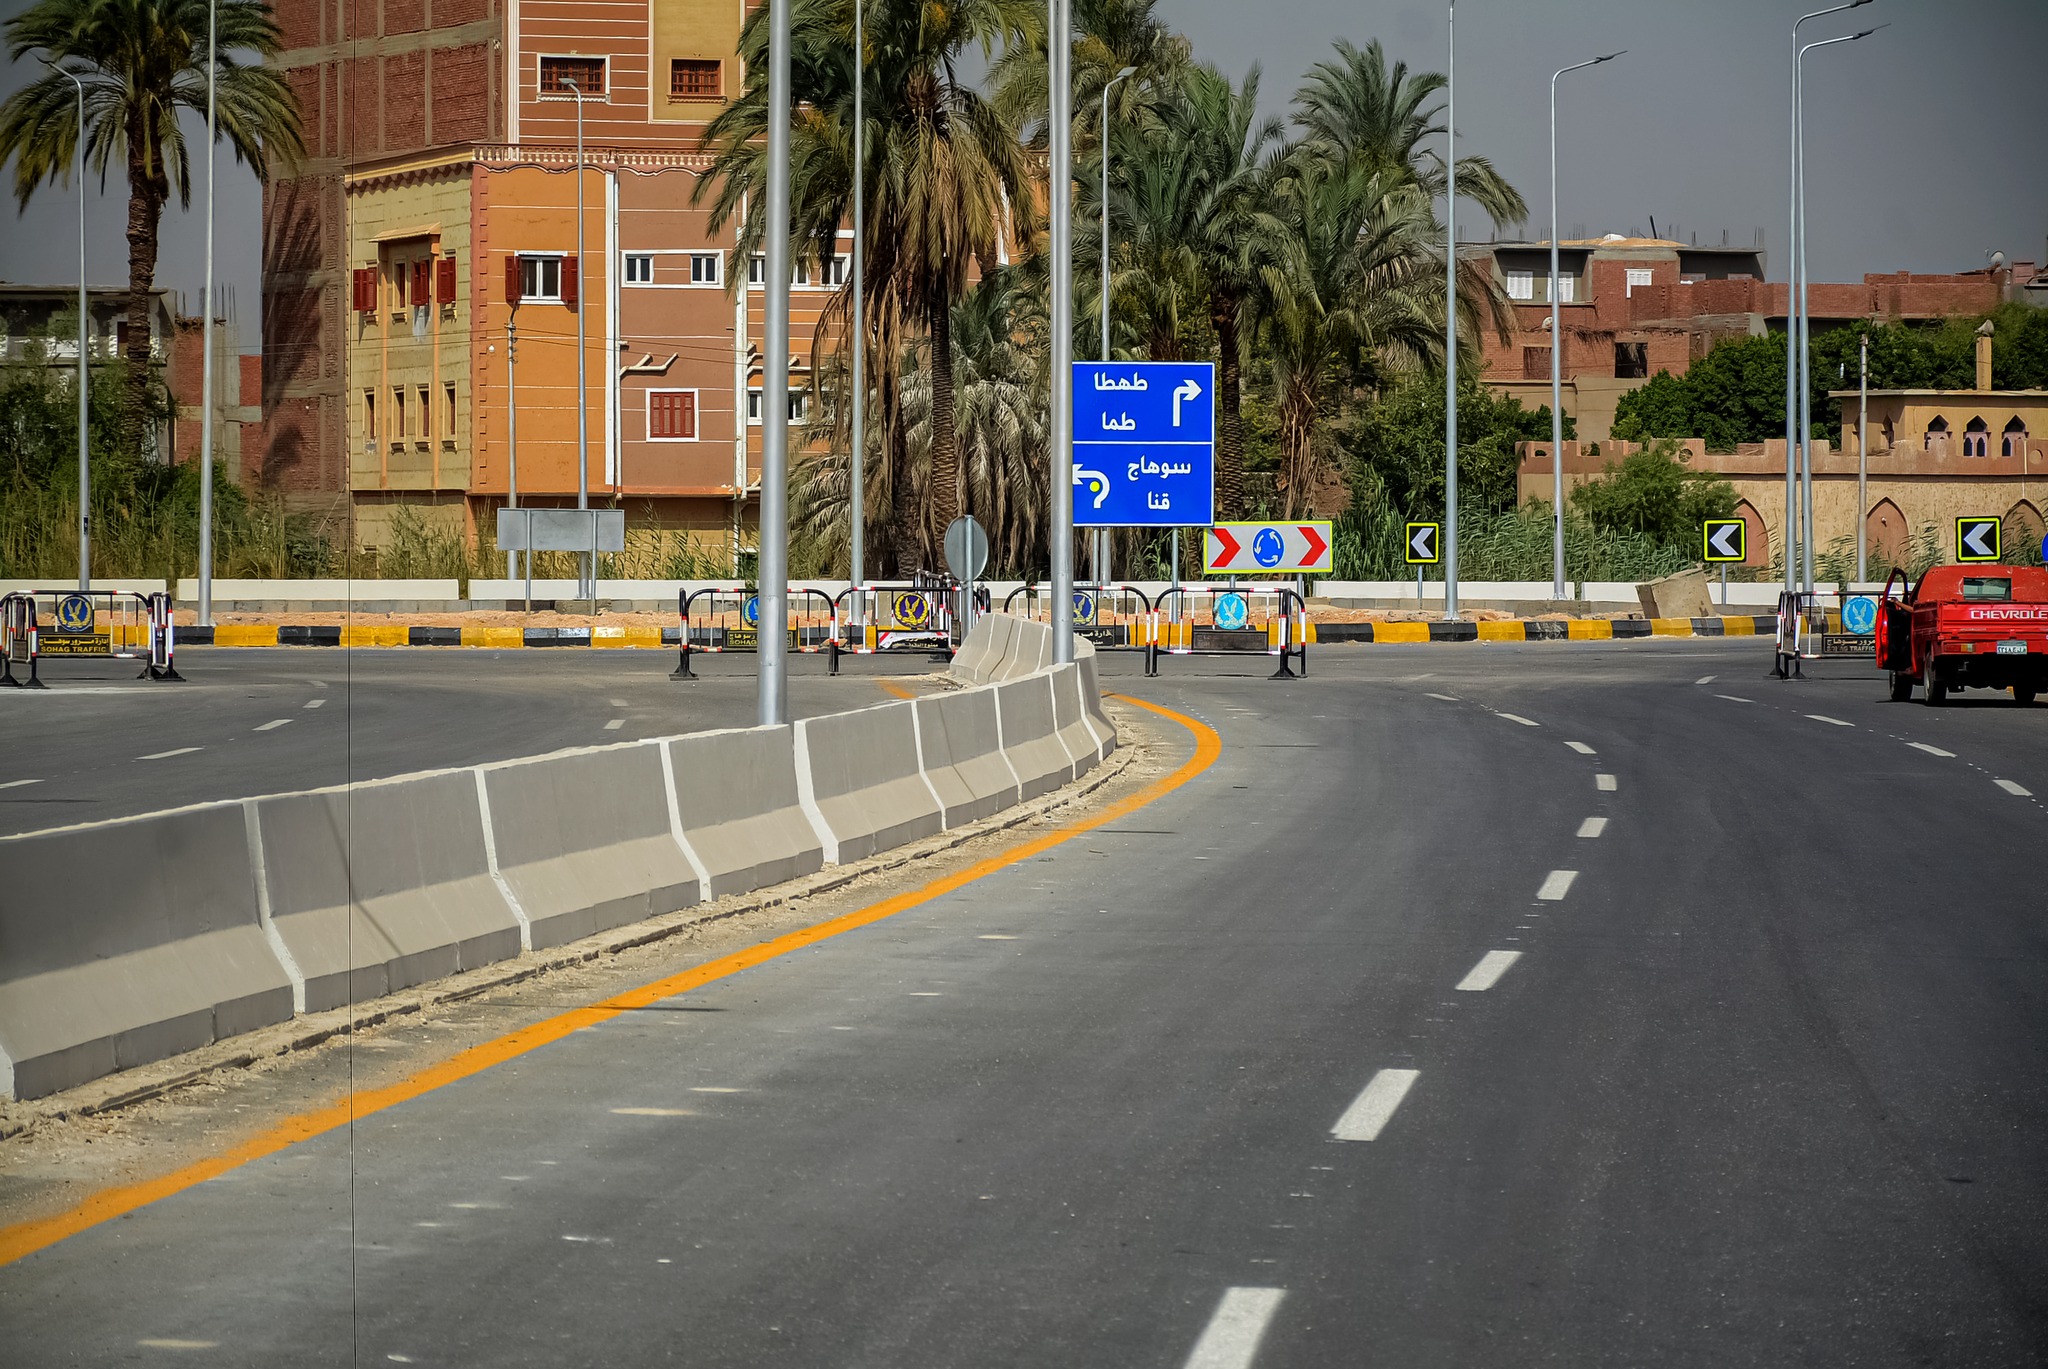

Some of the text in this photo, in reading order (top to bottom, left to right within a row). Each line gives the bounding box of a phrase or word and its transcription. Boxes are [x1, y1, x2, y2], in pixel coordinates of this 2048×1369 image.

[1094, 372, 1148, 391] طهطا
[1102, 411, 1136, 430] طما
[1128, 455, 1191, 481] سوهاج
[1147, 491, 1170, 510] قنا
[1971, 610, 2048, 619] CHEVROLE
